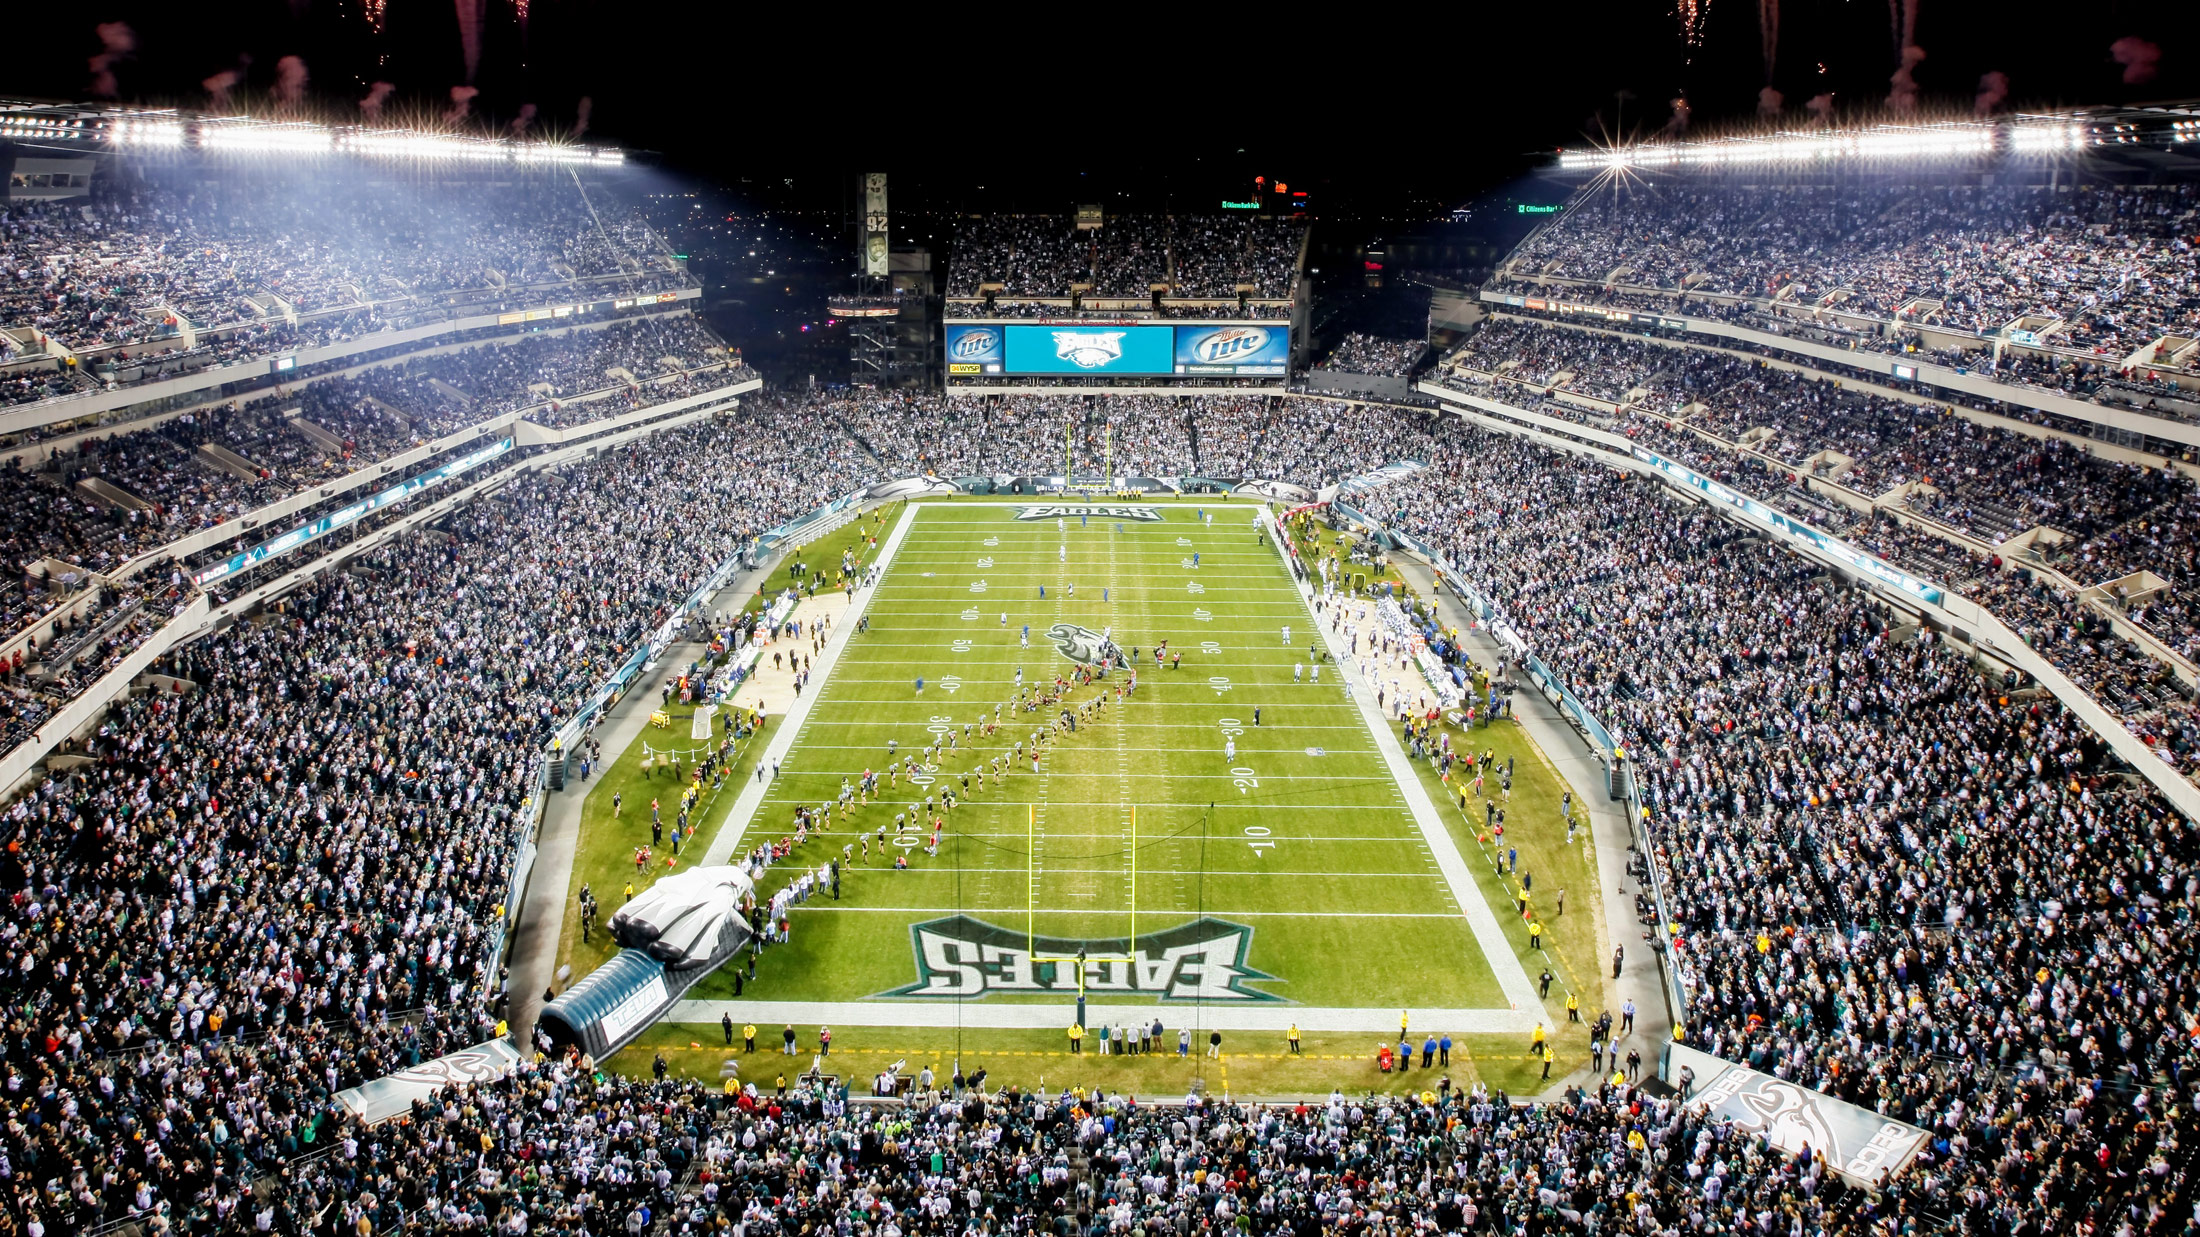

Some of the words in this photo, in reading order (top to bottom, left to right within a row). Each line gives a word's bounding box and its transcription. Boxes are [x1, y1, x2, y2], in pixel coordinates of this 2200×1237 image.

[866, 216, 888, 232] 92
[1216, 330, 1248, 342] Miller
[959, 336, 993, 358] Lite
[1208, 335, 1260, 361] Lite
[1018, 506, 1160, 520] EAGLES
[970, 582, 987, 592] 30
[1187, 584, 1205, 594] 30
[1193, 610, 1212, 622] 40
[951, 639, 972, 652] 50
[1200, 641, 1222, 654] 50
[940, 674, 962, 689] 40
[1209, 677, 1232, 692] 40
[927, 716, 952, 733] 30
[1218, 718, 1244, 736] 30
[1230, 767, 1259, 788] 20
[892, 825, 922, 846] 10
[1244, 826, 1276, 849] 10
[906, 929, 1254, 998] EAGLES
[612, 984, 658, 1027] TEVA
[1846, 1122, 1909, 1178] GEICO
